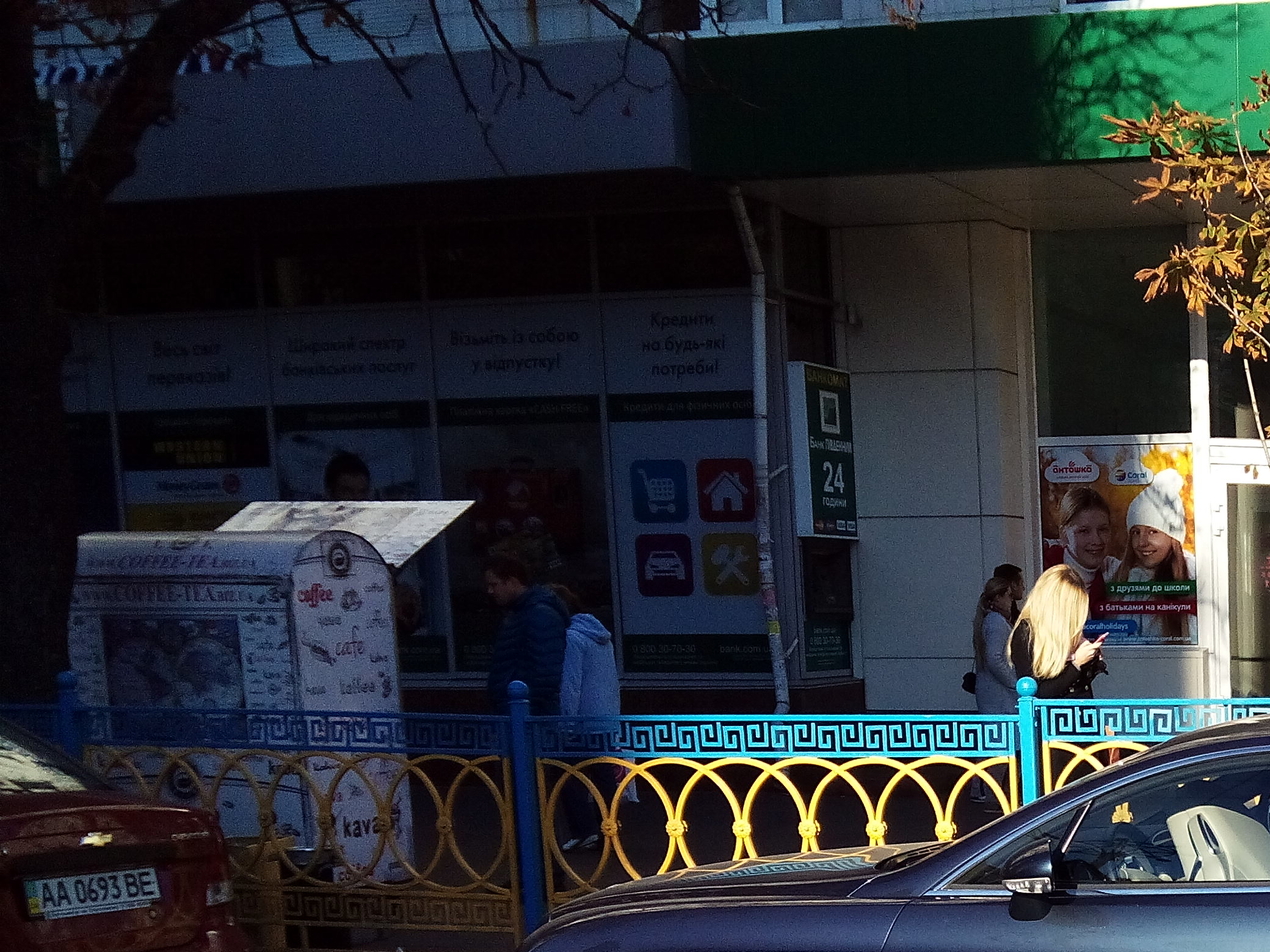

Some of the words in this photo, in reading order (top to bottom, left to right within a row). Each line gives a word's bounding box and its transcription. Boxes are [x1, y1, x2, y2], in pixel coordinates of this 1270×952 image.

[651, 312, 714, 329] Кредити
[288, 336, 355, 356] Широкий
[359, 338, 406, 354] спектр
[450, 330, 508, 346] Візьміть
[513, 331, 524, 344] із
[529, 328, 580, 344] собою
[642, 342, 660, 352] на
[664, 334, 726, 353] будь-які
[152, 341, 189, 358] Весь
[193, 341, 221, 356] світ
[282, 362, 365, 379] банківських
[369, 361, 416, 377] послуг
[472, 360, 480, 374] у
[485, 354, 561, 373] відпустку!
[652, 360, 719, 378] потреби!
[147, 366, 232, 388] переказів!
[806, 369, 849, 388] БАНКОМАТ
[622, 402, 662, 413] Кредити
[666, 402, 685, 413] для
[686, 400, 731, 413] фізичних
[822, 460, 845, 494] 24
[1127, 471, 1147, 479] Coral
[297, 583, 335, 608] coffee
[1116, 584, 1150, 593] друзями
[1152, 584, 1162, 593] до
[1164, 584, 1191, 592] школи
[1105, 603, 1144, 612] батьками
[1157, 602, 1191, 612] канікули
[640, 644, 657, 654] 800
[658, 644, 697, 654] 30-70-30
[42, 881, 72, 909] AA
[74, 875, 122, 904] 0693
[123, 871, 155, 898] BE
